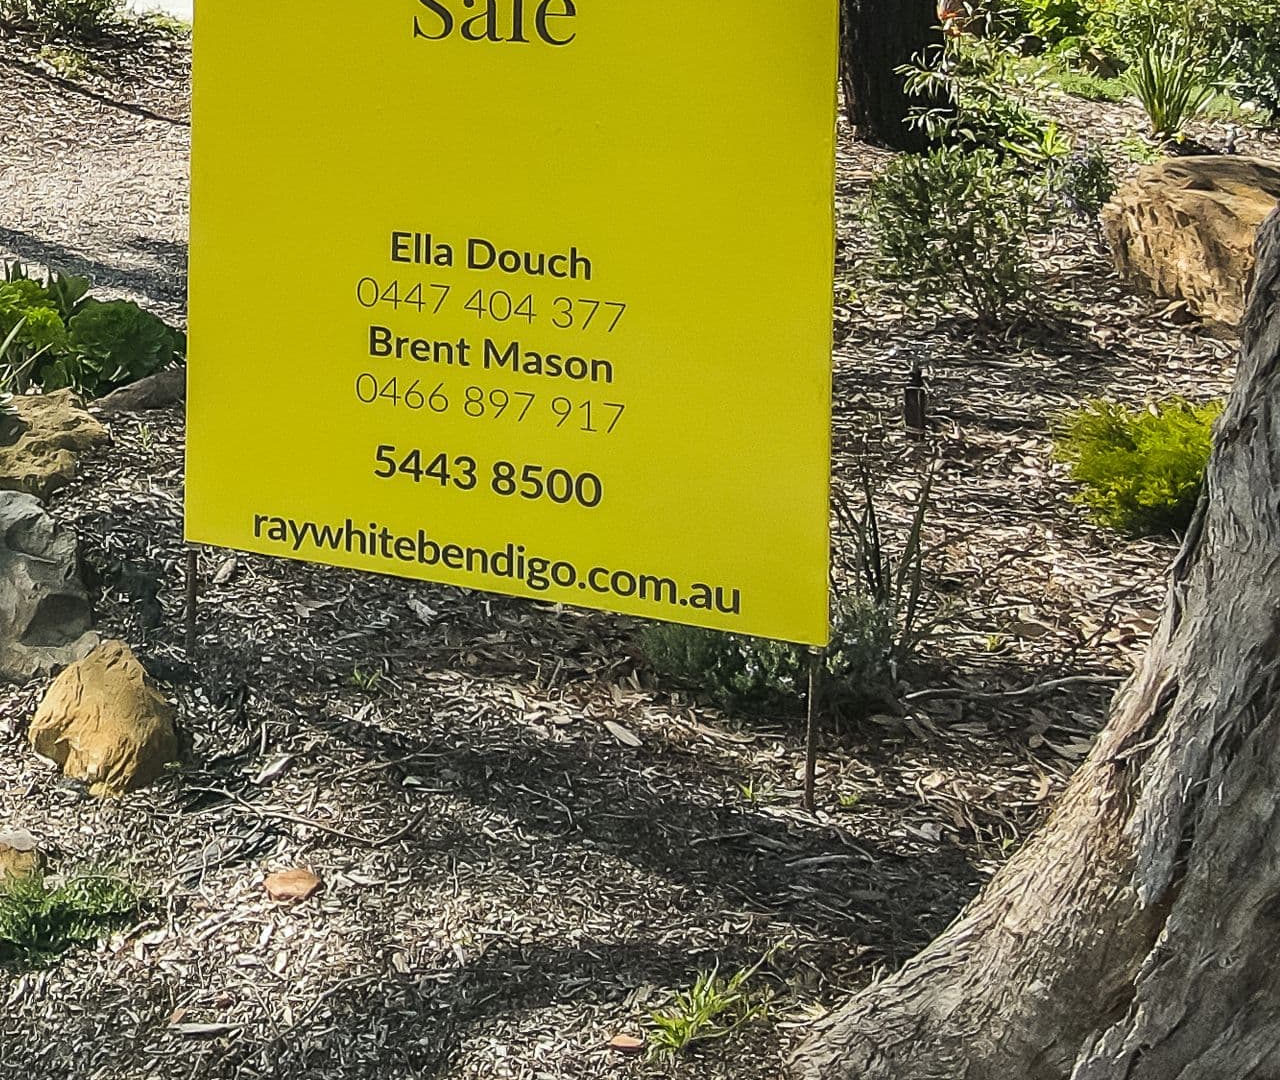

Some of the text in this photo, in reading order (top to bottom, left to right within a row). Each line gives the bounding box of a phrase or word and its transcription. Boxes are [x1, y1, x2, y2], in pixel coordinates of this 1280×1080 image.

[391, 231, 592, 281] Ella Douch
[356, 276, 627, 333] 0447 404 377
[369, 325, 613, 384] Brent Mason
[356, 372, 625, 434] 0466 897 917
[373, 444, 602, 508] 5443 8500
[252, 513, 740, 615] raywhitebendigo.com.au
